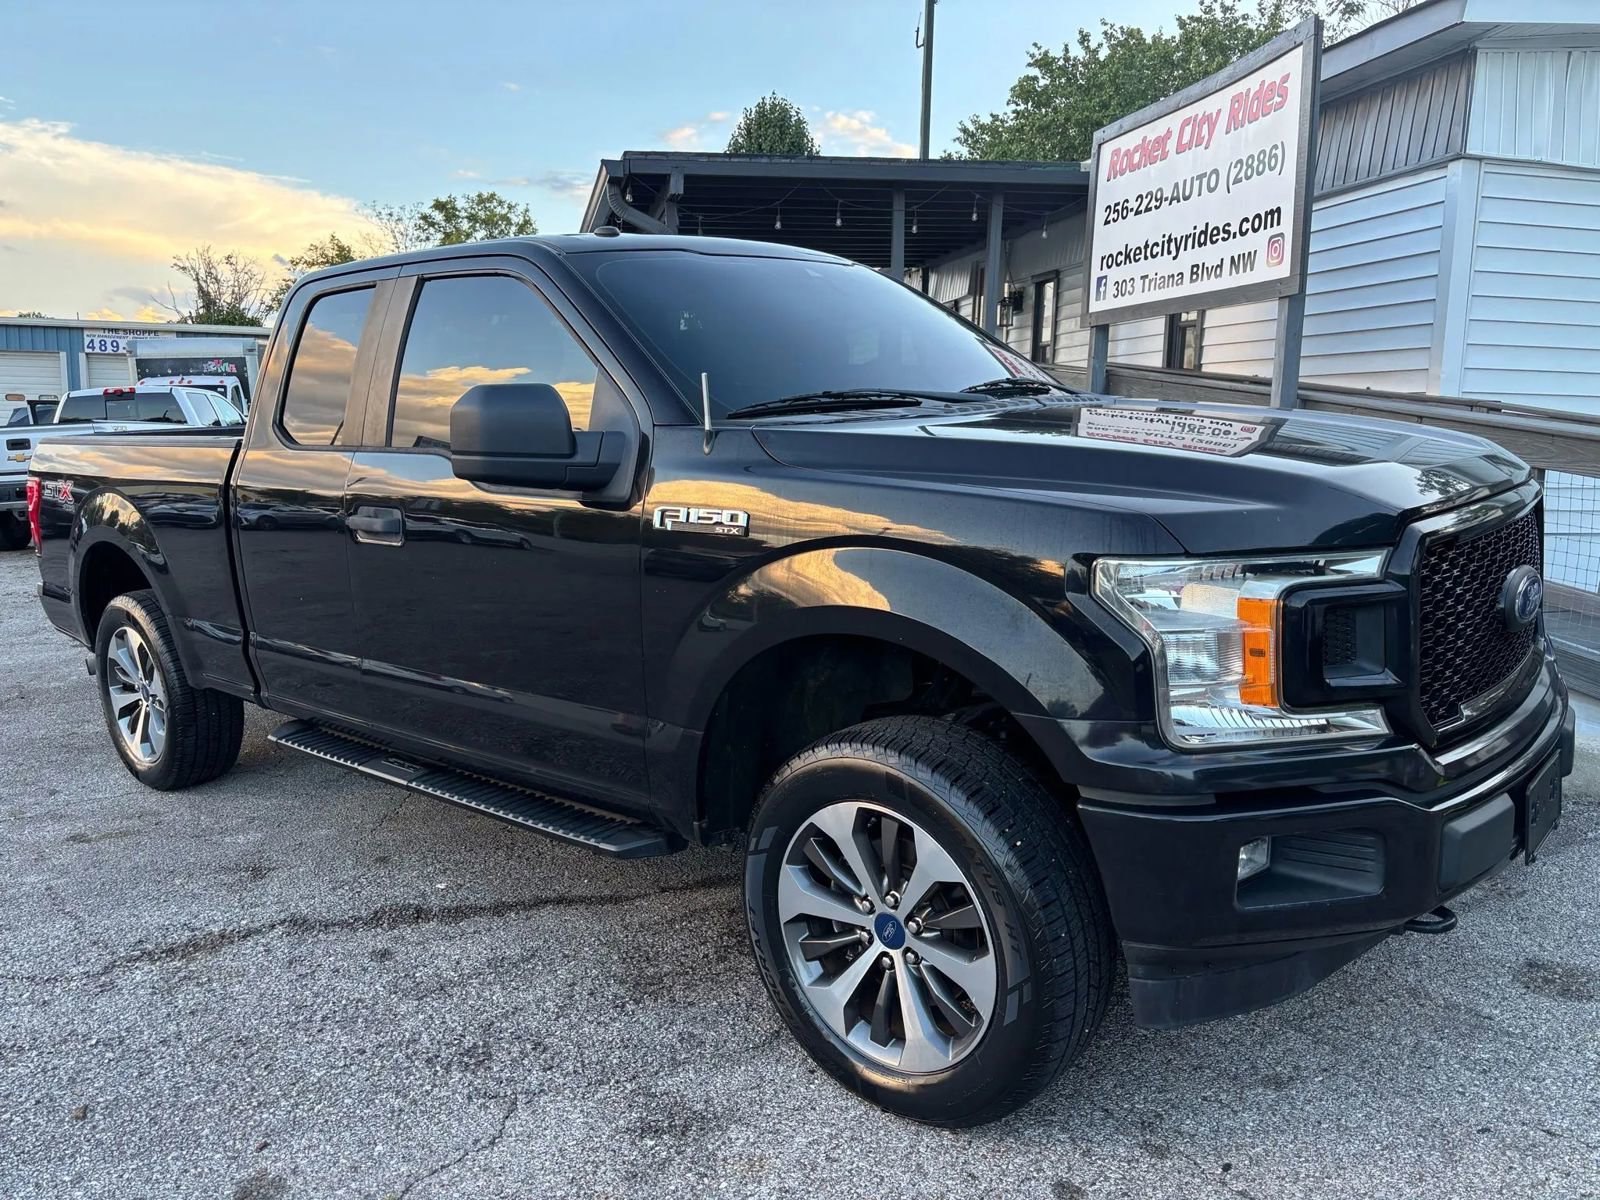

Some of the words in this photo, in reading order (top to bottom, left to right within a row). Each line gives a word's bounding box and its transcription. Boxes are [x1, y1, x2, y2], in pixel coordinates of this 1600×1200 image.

[1106, 127, 1172, 182] Rocket
[1175, 107, 1222, 155] City
[1224, 72, 1291, 135] Rides
[1103, 167, 1220, 226] 256-229-AUTO
[1226, 141, 1286, 194] (2886)
[1100, 205, 1282, 271] rocketcityrides.com
[1112, 277, 1135, 299] 303
[1140, 271, 1184, 295] Triana
[1189, 258, 1224, 284] Blvd
[1228, 250, 1258, 277] NW
[44, 479, 74, 504] STX
[715, 526, 740, 535] STX
